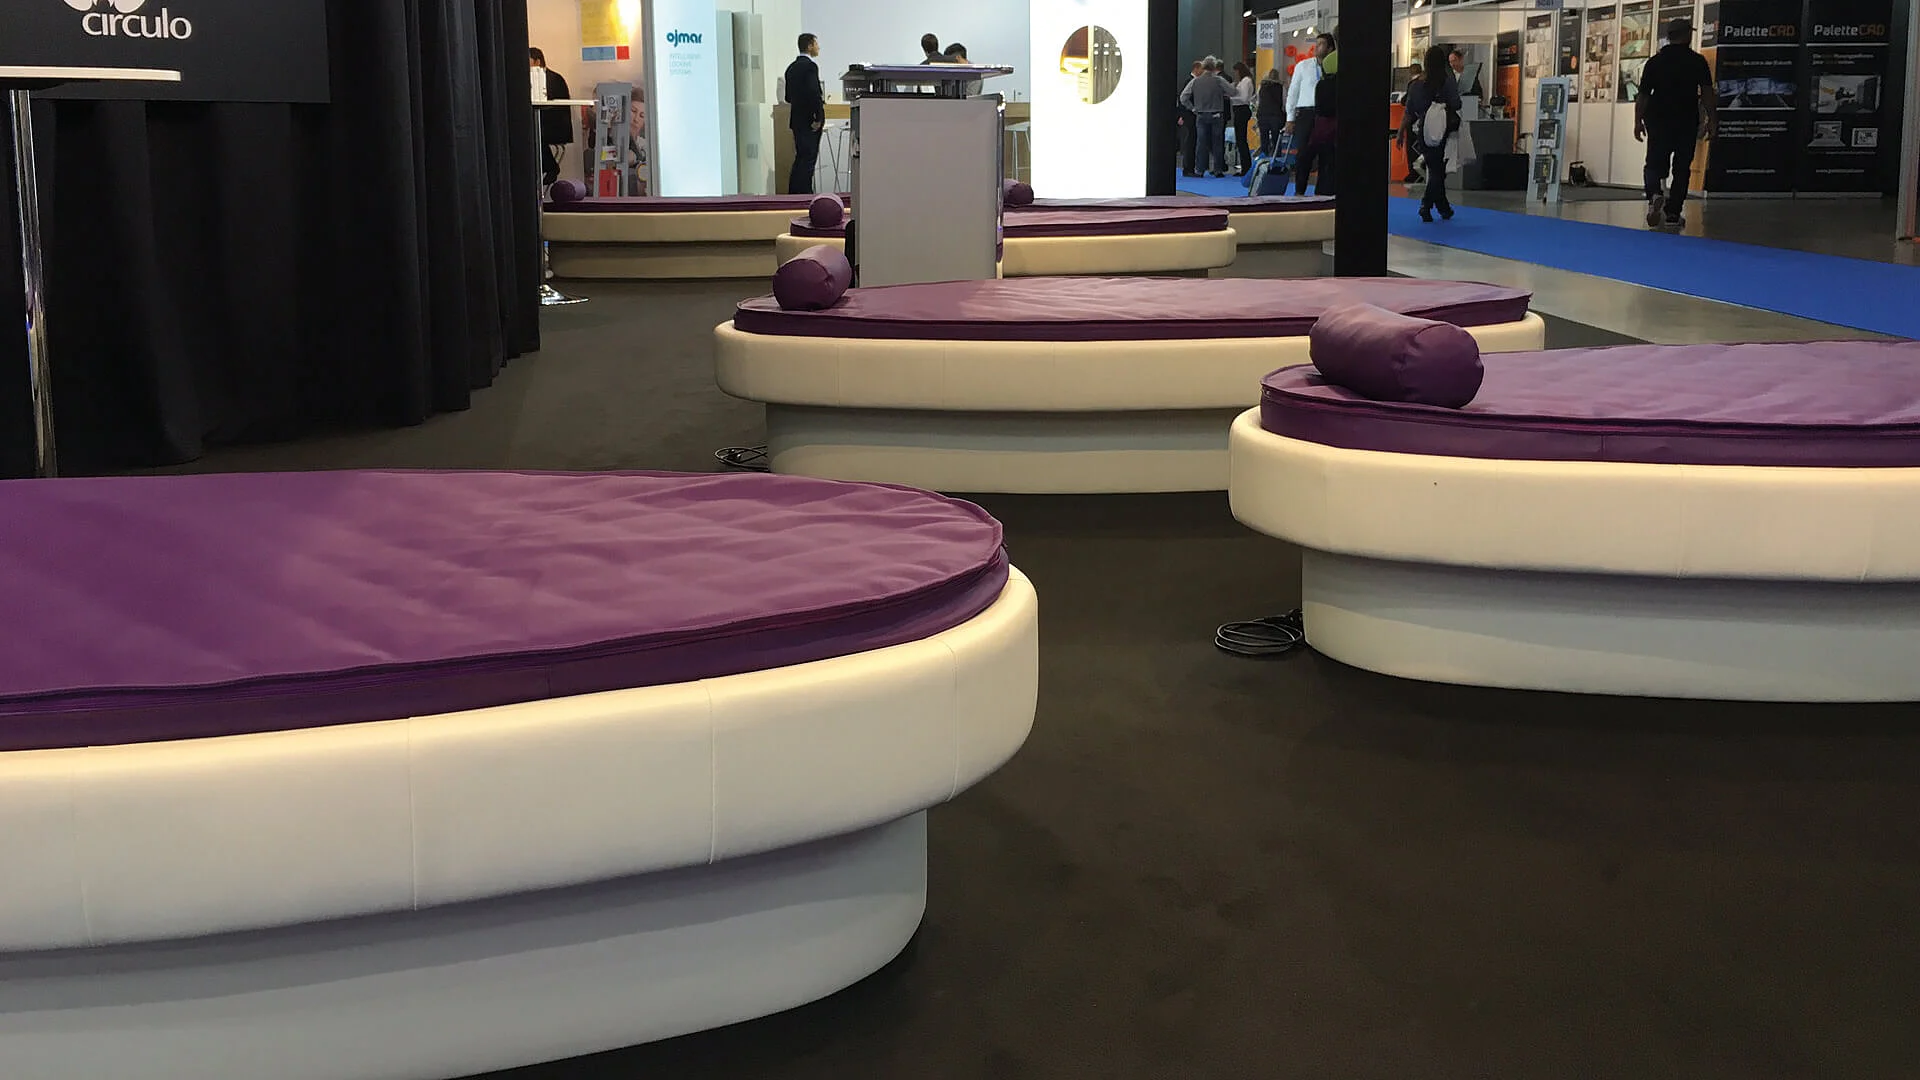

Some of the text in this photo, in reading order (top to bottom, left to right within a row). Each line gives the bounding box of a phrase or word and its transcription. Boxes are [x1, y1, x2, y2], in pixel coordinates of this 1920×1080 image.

[82, 7, 192, 40] circulo
[1724, 24, 1796, 37] PaletteCAD
[1813, 23, 1886, 37] PaletteCAD
[666, 28, 702, 48] ojmar
